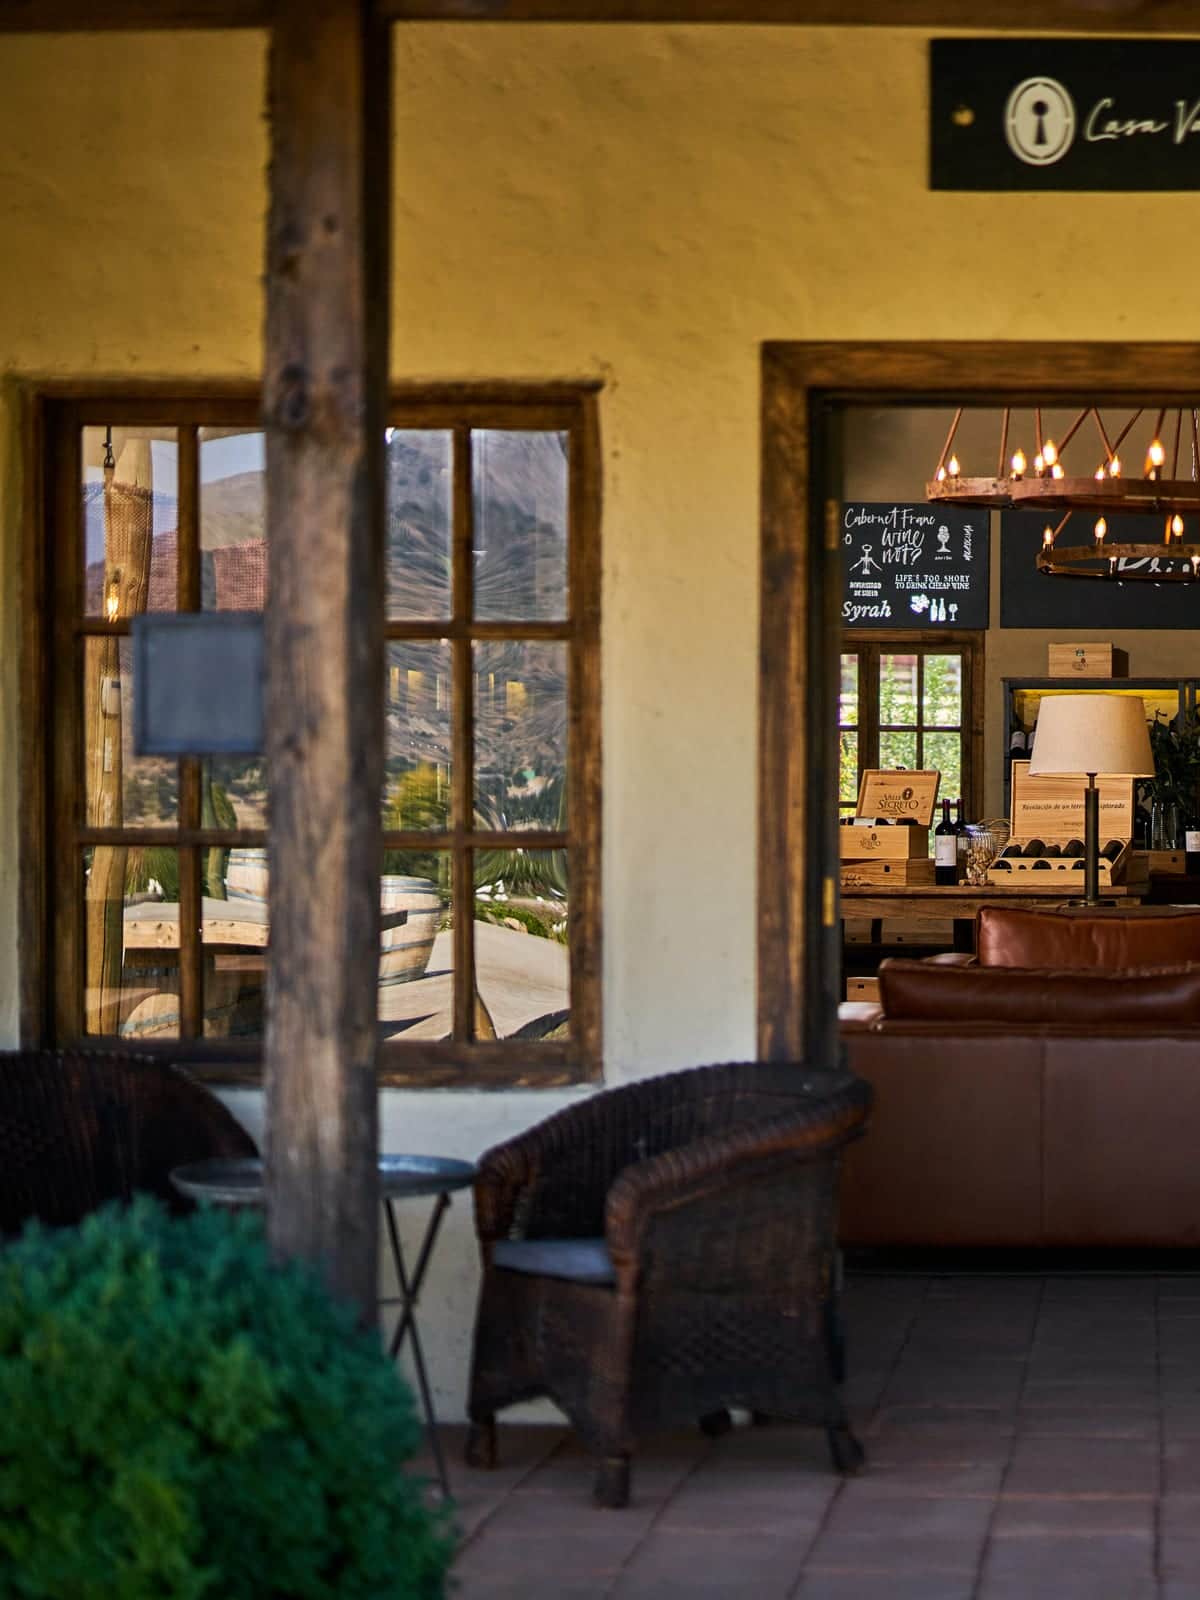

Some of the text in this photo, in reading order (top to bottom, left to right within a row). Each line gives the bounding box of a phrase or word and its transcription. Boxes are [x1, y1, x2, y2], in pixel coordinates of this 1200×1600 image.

[1086, 99, 1168, 141] Casa
[844, 507, 900, 529] Cabernet
[923, 574, 940, 583] TOO
[841, 600, 892, 622] Syrah
